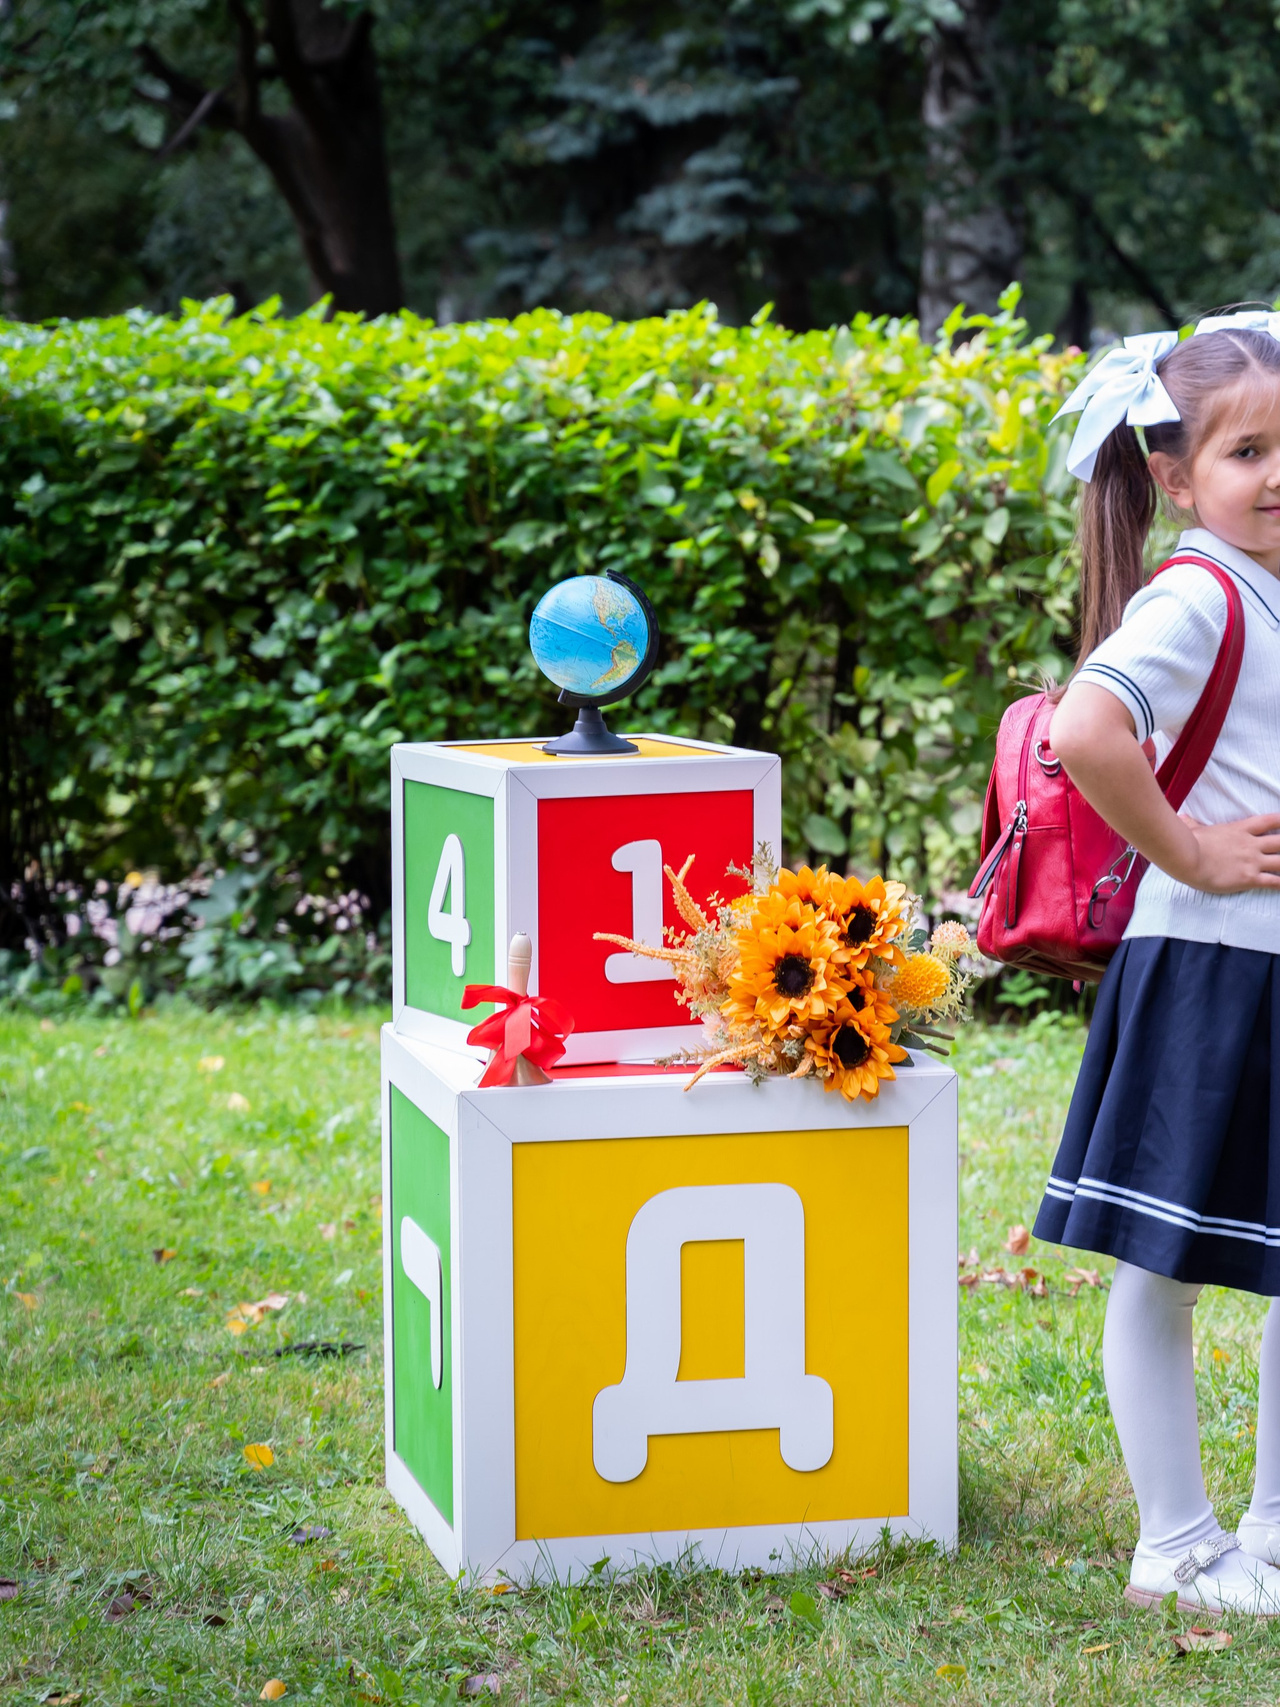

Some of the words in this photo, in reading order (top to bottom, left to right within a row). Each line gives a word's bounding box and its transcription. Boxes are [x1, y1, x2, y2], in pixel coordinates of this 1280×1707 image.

[427, 833, 472, 977] 4
[605, 839, 678, 984] 1
[592, 1182, 834, 1484] Д
